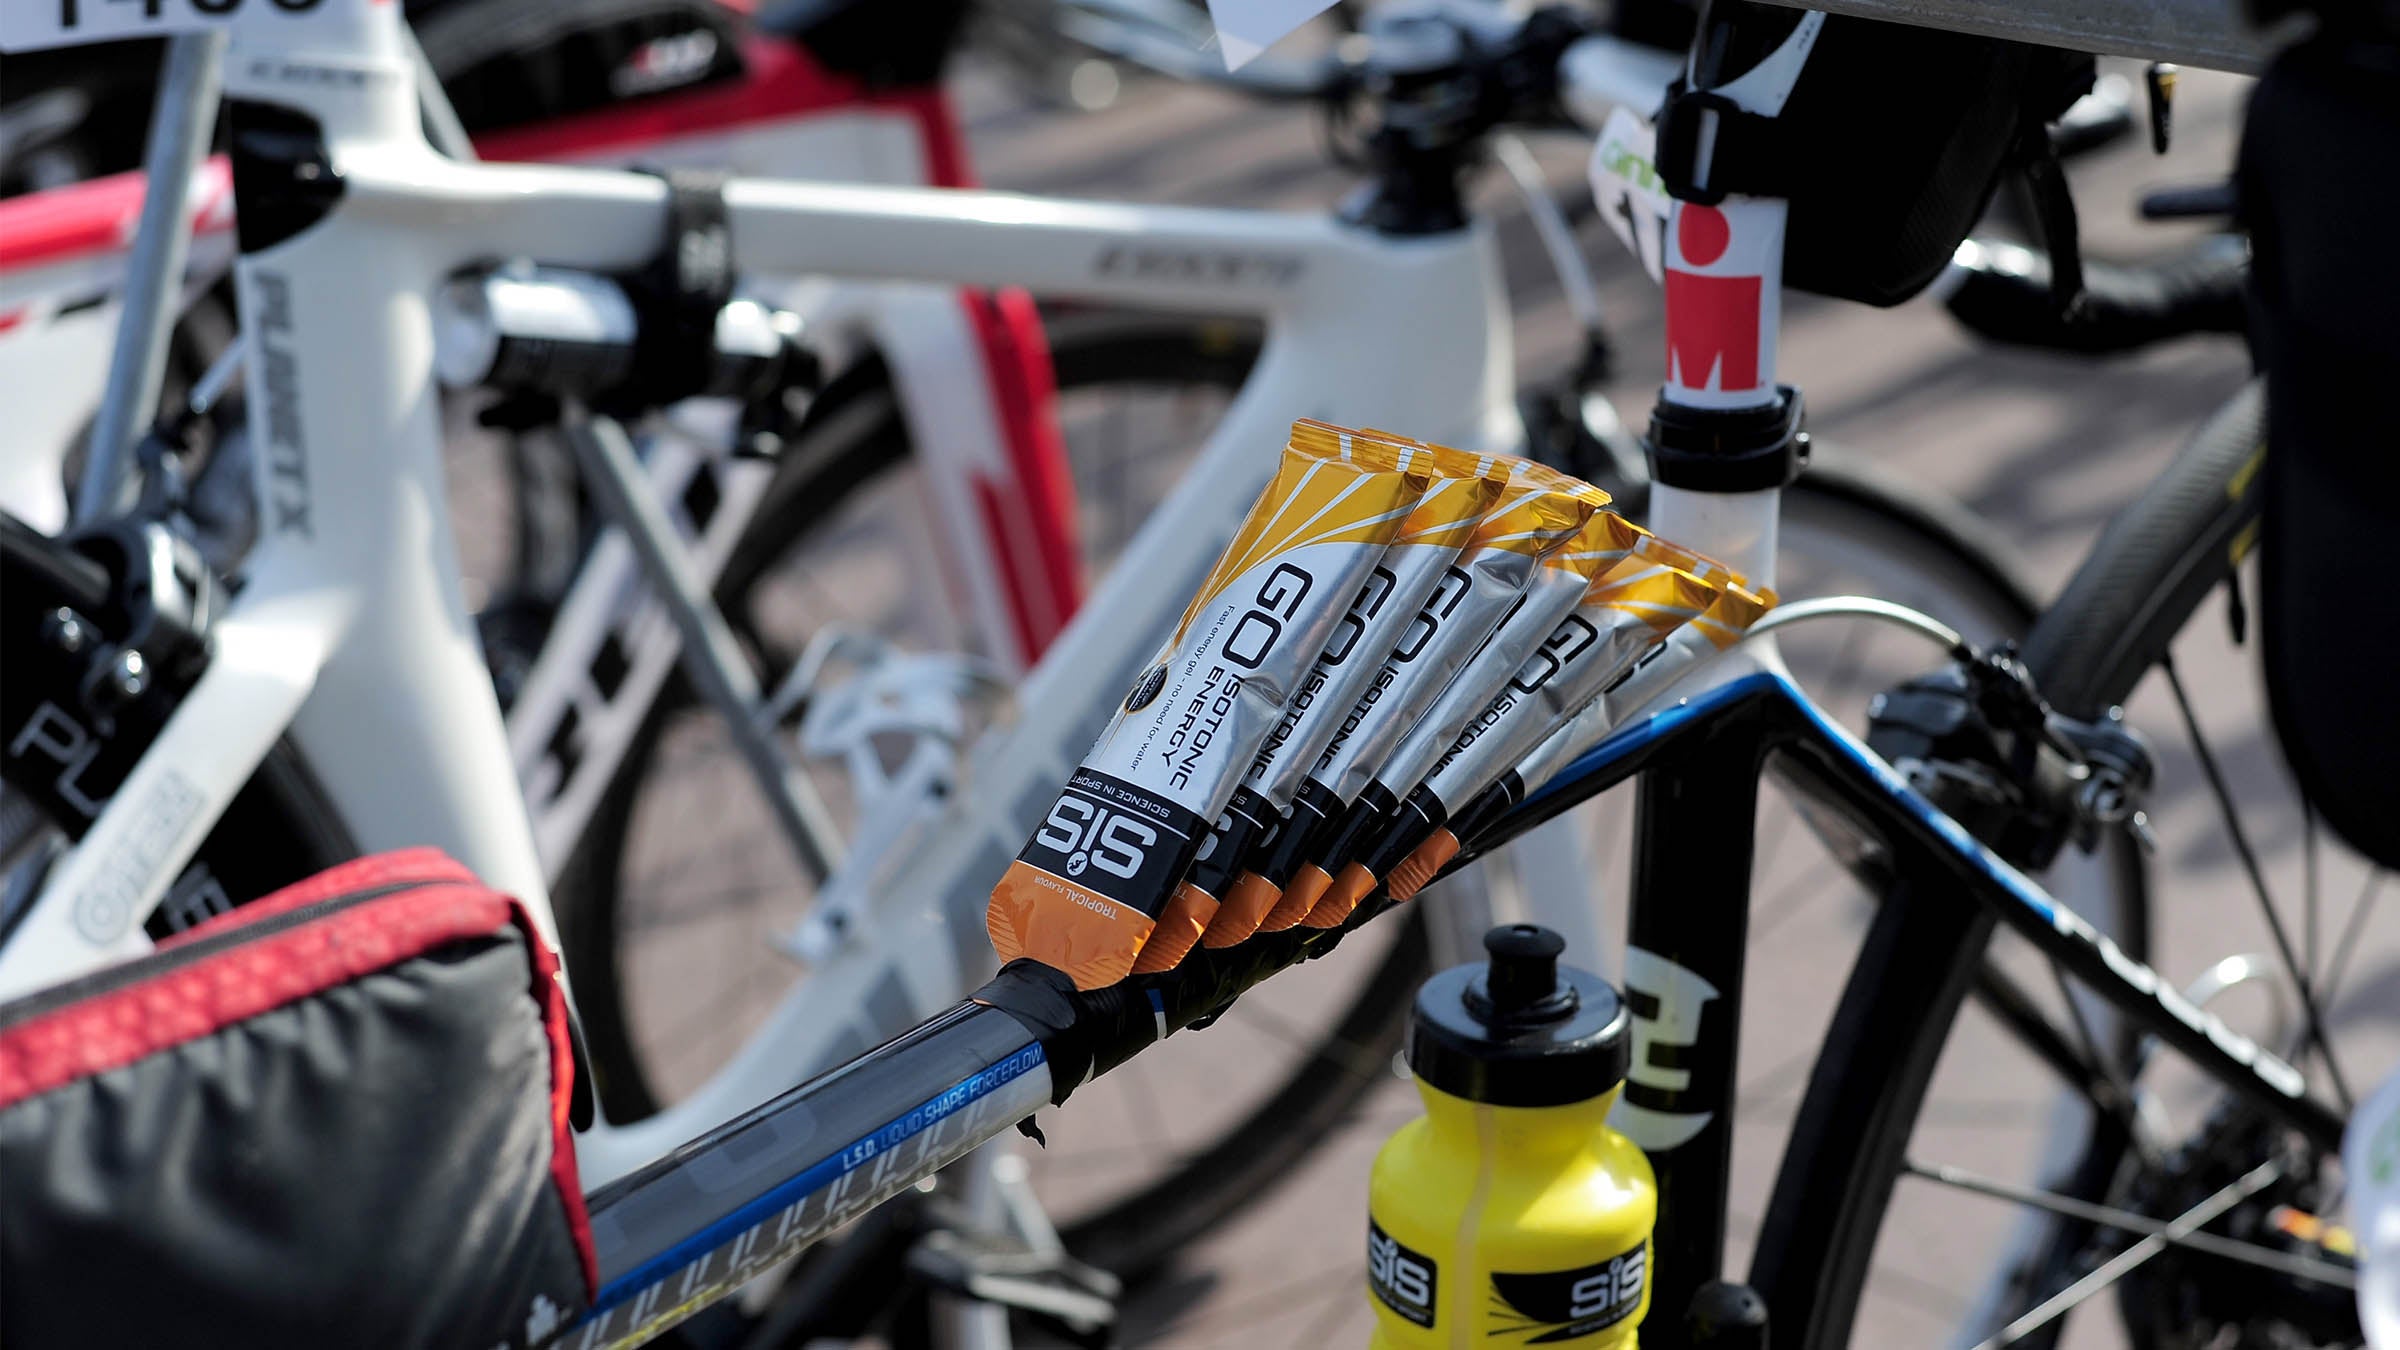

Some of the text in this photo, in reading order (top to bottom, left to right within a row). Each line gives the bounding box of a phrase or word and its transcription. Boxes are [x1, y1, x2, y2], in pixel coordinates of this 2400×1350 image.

[1218, 605, 1235, 626] Fast
[1222, 562, 1313, 669] GO
[1195, 627, 1219, 659] energy
[1185, 660, 1197, 677] gel
[1171, 684, 1183, 698] no
[1156, 699, 1174, 726] need
[1162, 665, 1225, 767] ENERGY
[1147, 726, 1160, 742] for
[1169, 673, 1245, 790] ISOTONIC
[1130, 743, 1150, 772] water
[1071, 775, 1170, 819] SCIENCE IN SPORT
[1034, 875, 1117, 920] TROPICAL FLAVOUR
[843, 1045, 1044, 1169] L.S.D. LIQUID SHAPE FORCEFLOW
